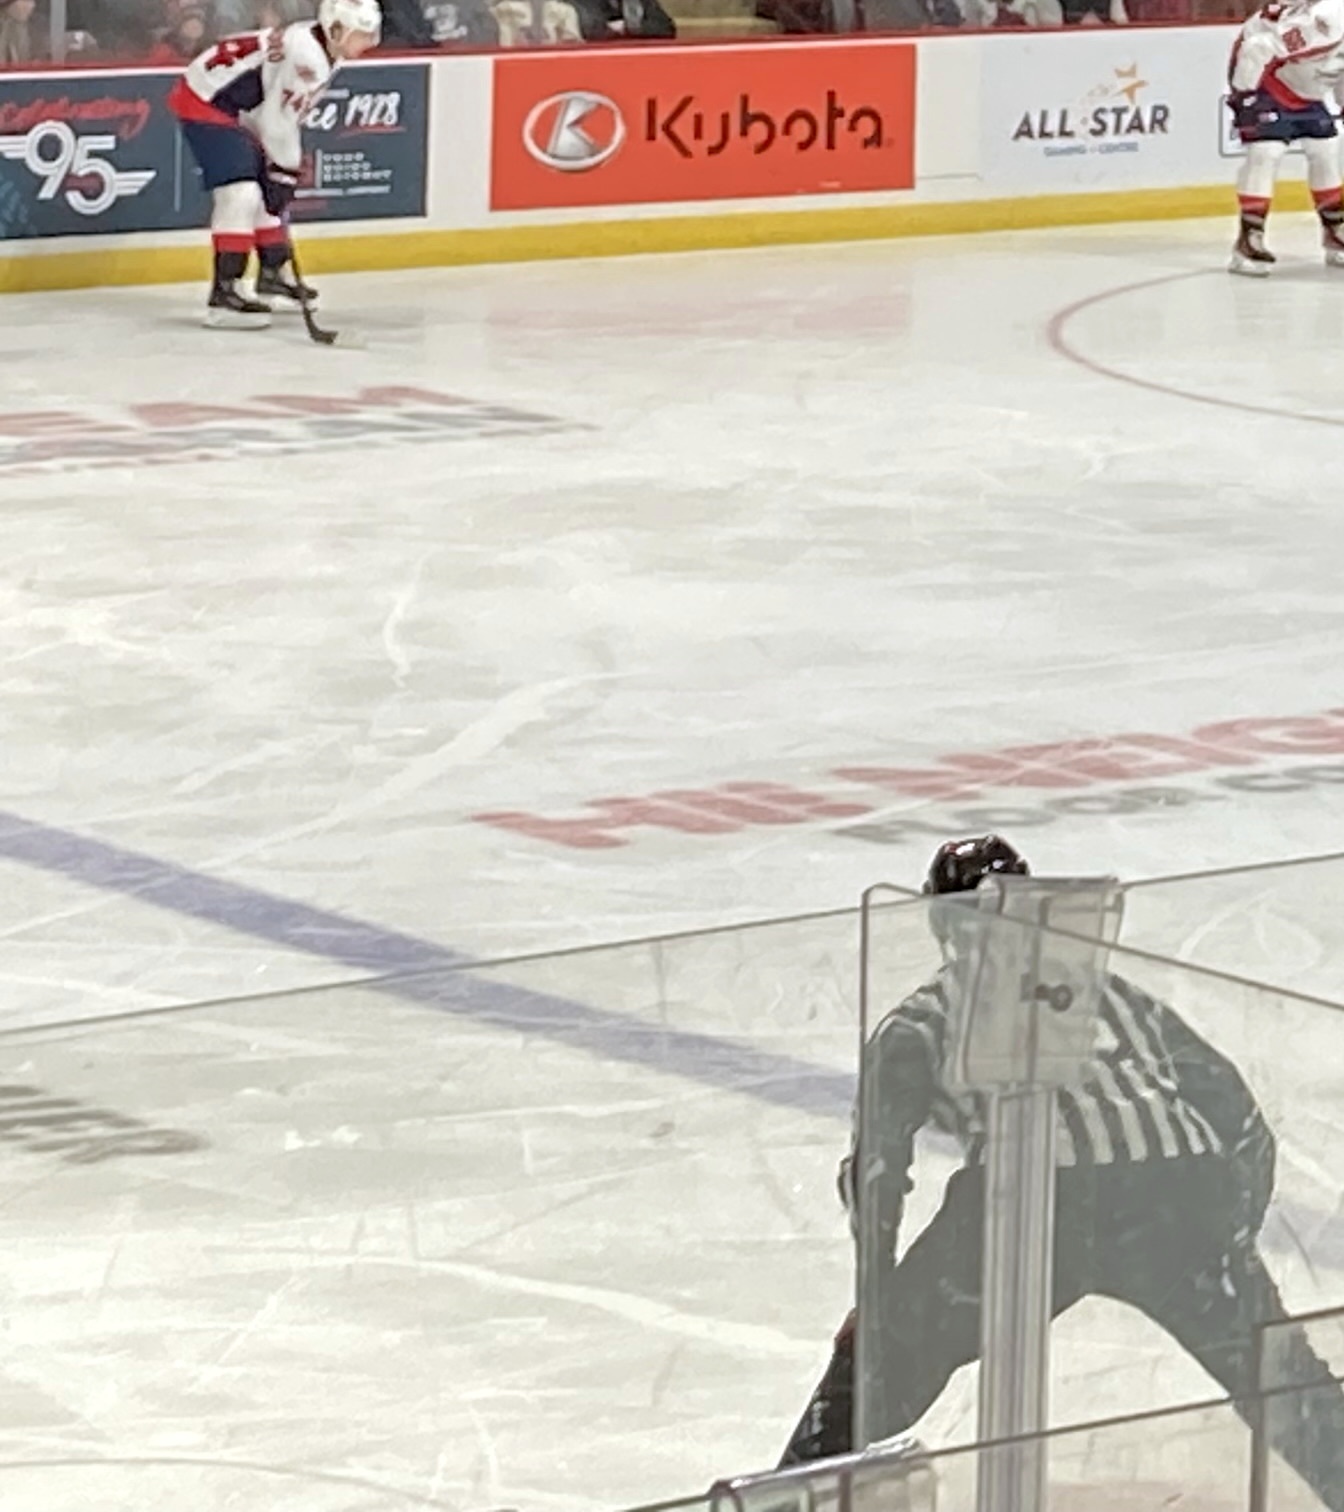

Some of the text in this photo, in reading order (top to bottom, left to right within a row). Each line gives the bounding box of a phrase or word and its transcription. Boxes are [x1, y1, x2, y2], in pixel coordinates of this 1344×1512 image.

[645, 89, 885, 159] Kubota
[1011, 104, 1170, 141] ALL STAR
[24, 119, 119, 216] 95
